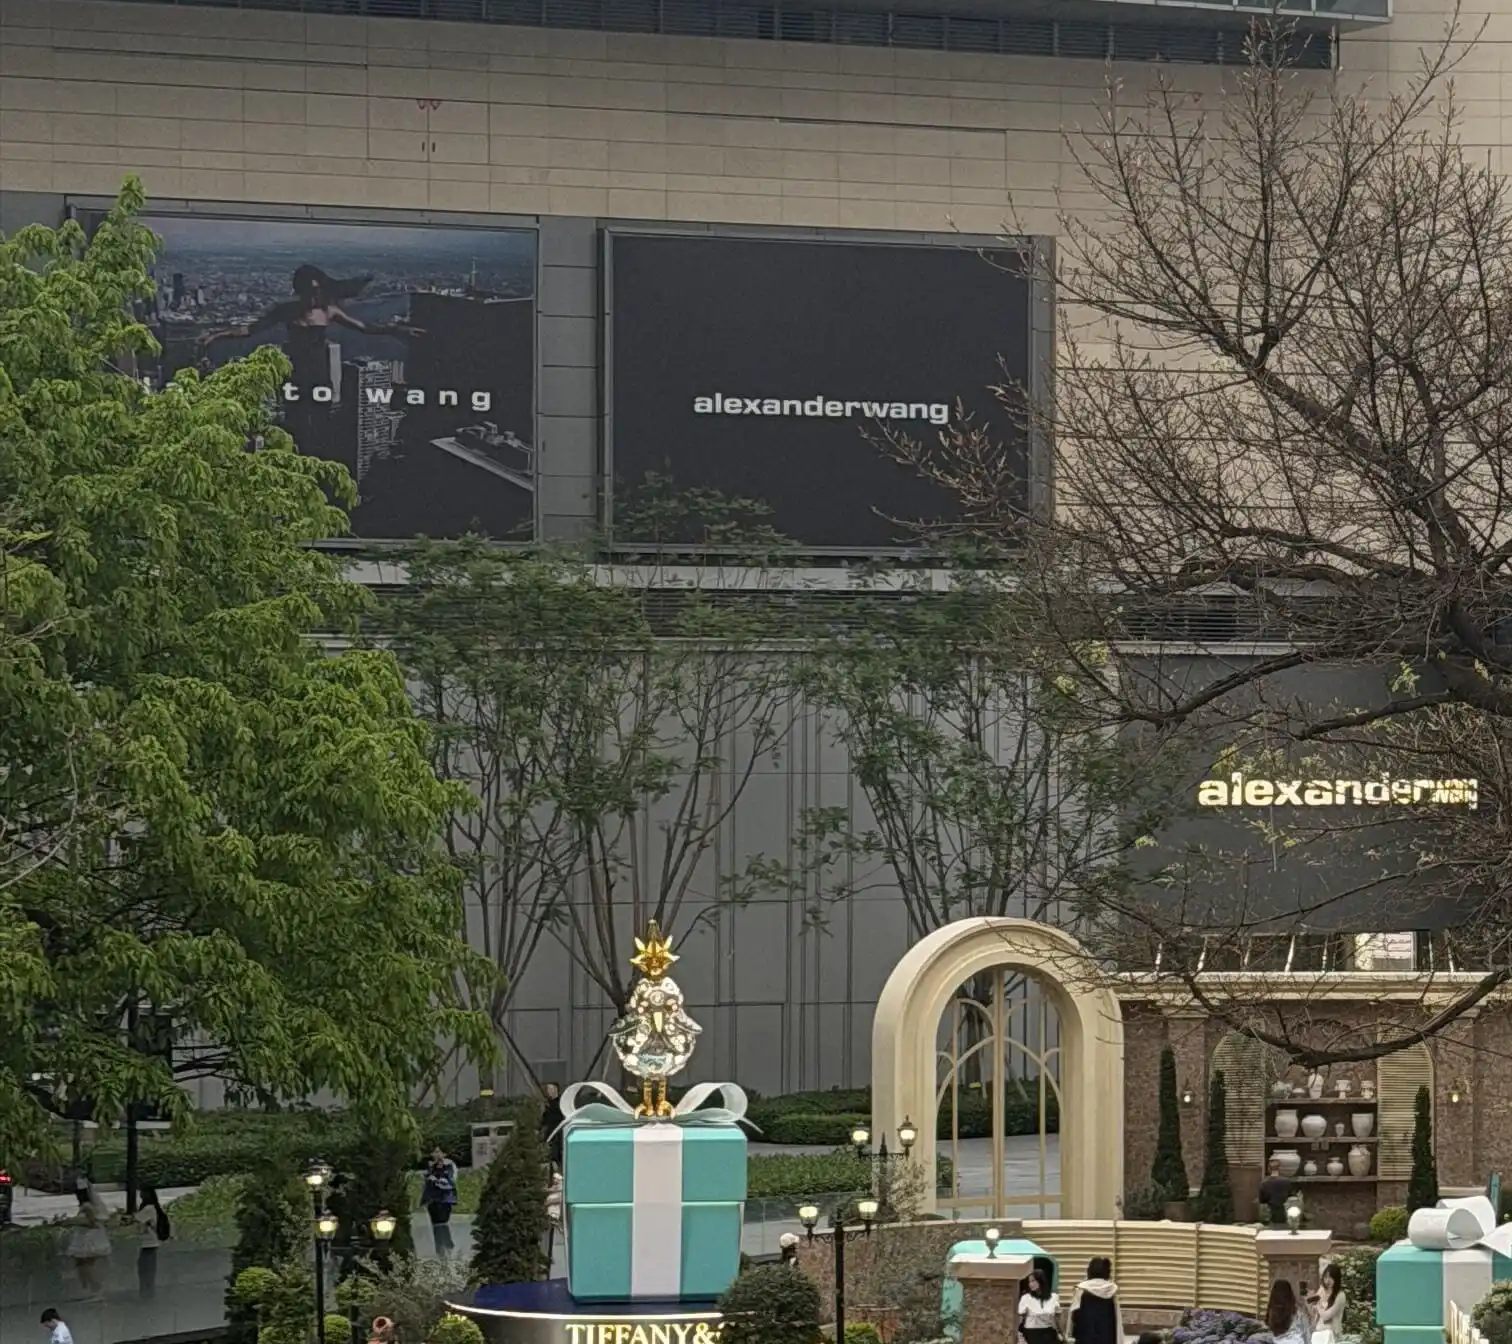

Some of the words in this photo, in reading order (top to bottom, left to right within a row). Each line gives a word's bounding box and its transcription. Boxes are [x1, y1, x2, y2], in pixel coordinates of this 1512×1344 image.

[283, 381, 332, 403] to
[366, 387, 491, 412] wang
[694, 392, 949, 425] alexanderwang
